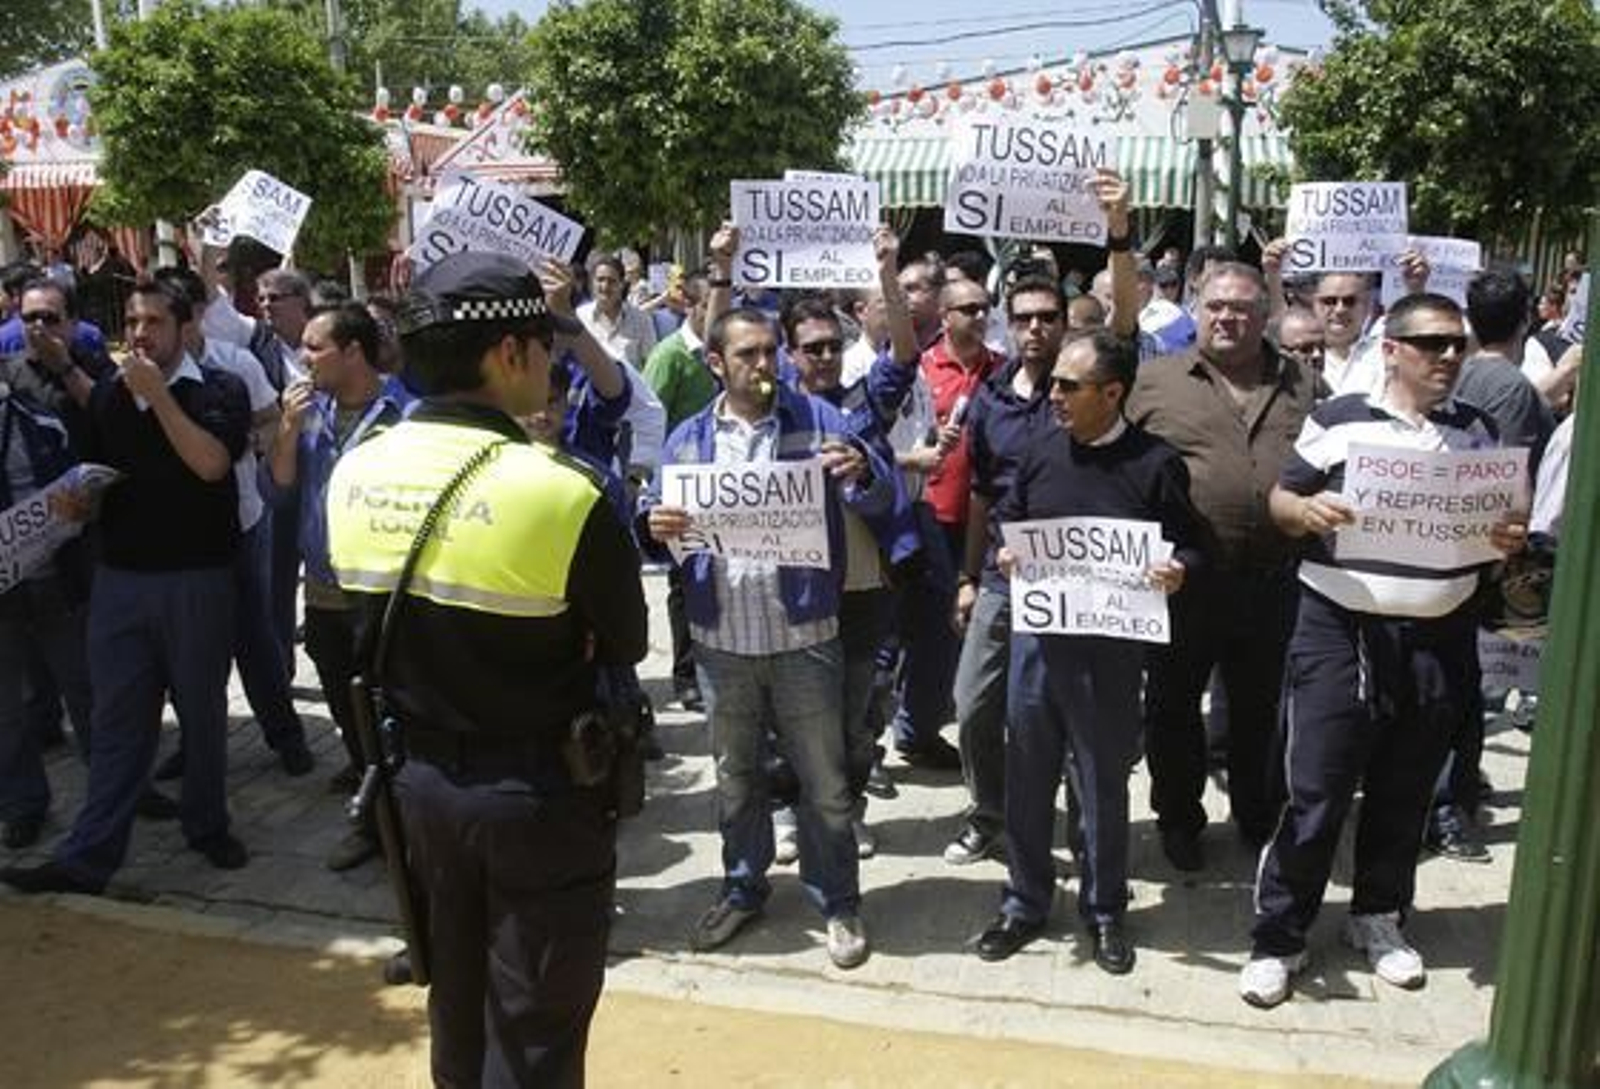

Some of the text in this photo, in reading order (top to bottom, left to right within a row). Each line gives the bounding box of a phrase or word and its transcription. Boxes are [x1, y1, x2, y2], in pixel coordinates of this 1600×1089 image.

[971, 124, 1106, 168] TUSSAM
[746, 189, 869, 222] TUSSAM
[955, 190, 1004, 231] SI
[1047, 198, 1072, 216] AL
[1302, 188, 1399, 216] TUSSAM
[458, 175, 572, 257] TUSSAM
[1010, 216, 1102, 239] EMPLEO
[741, 249, 783, 283] SI
[819, 250, 843, 264] AL
[1290, 238, 1326, 269] SI
[790, 267, 873, 283] EMPLEO
[1358, 456, 1425, 480] PSOE
[1455, 462, 1517, 481] PARO
[676, 470, 814, 508] TUSSAM
[1355, 488, 1371, 504] Y
[1362, 516, 1396, 534] EN
[762, 533, 782, 546] AL
[1021, 527, 1149, 567] TUSSAM
[1023, 590, 1067, 628] SI
[1107, 594, 1130, 610] AL
[1076, 614, 1163, 636] EMPLEO
